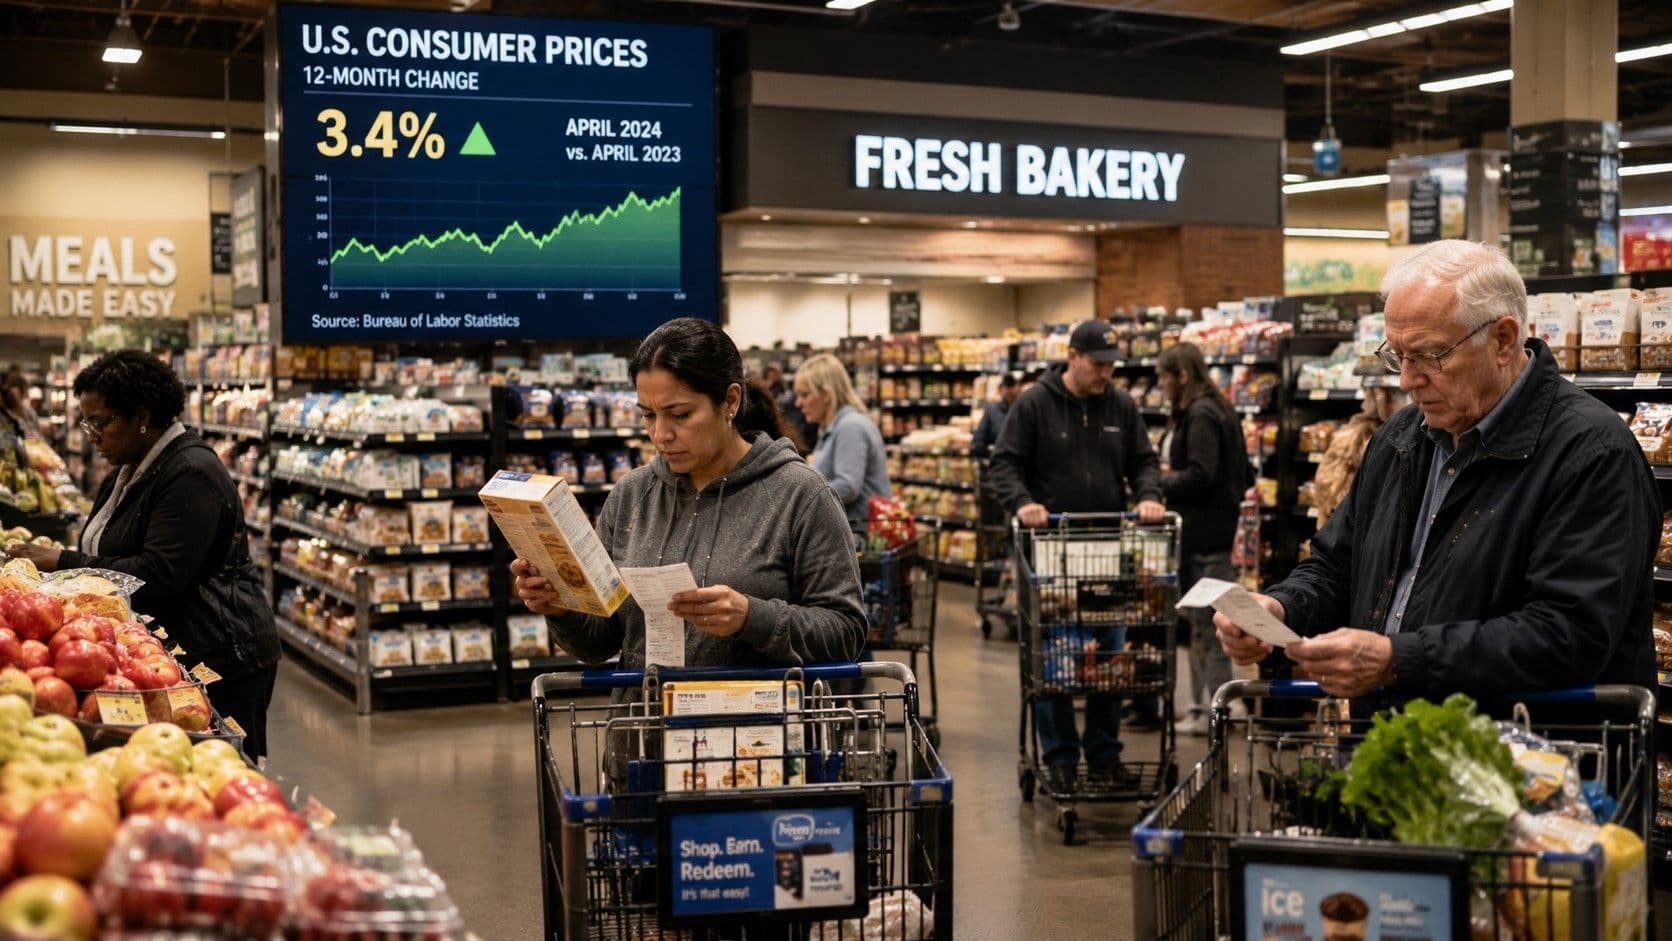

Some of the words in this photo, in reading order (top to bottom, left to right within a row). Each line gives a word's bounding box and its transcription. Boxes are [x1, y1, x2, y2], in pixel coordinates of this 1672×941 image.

[302, 24, 358, 55] U.S.
[366, 27, 537, 63] CONSUMER
[545, 35, 648, 68] PRICES
[303, 66, 400, 88] 12-MONTH
[405, 69, 479, 90] CHANGE
[316, 108, 446, 159] 3.4%
[565, 118, 616, 138] APRIL
[620, 120, 662, 139] 2024
[565, 146, 588, 161] vs.
[592, 143, 639, 162] APRIL
[642, 145, 682, 163] 2023
[855, 134, 1001, 193] FRESH
[1017, 144, 1185, 202] BAKERY
[10, 234, 177, 286] MEALS
[11, 288, 93, 318] MADE
[103, 288, 176, 318] EASY
[312, 313, 360, 328] Source:
[363, 314, 407, 328] Bureau
[410, 313, 424, 328] of
[426, 314, 461, 328] Labor
[464, 313, 520, 328] Statistics
[680, 839, 723, 859] Shop.
[726, 837, 764, 855] Earn.
[680, 862, 754, 881] Redeem.
